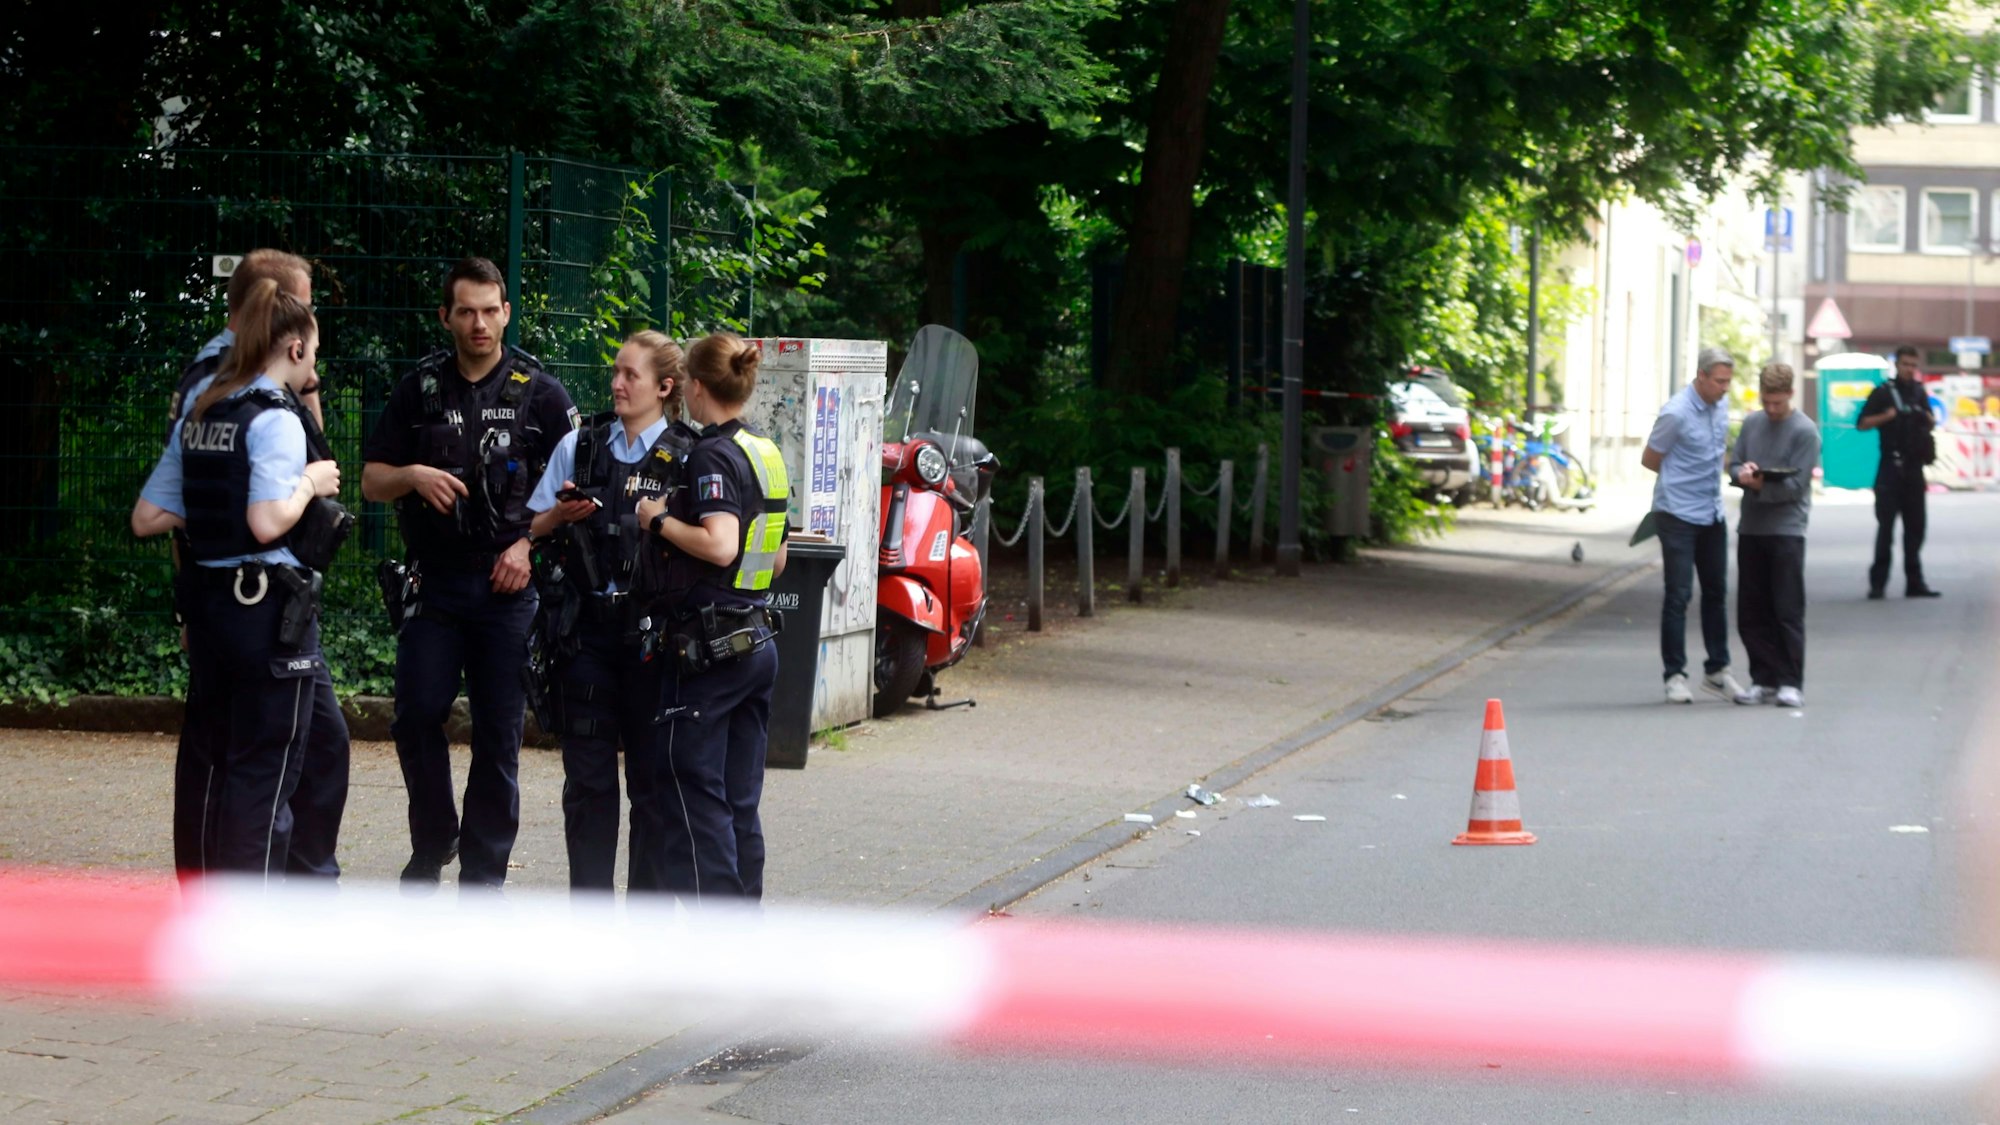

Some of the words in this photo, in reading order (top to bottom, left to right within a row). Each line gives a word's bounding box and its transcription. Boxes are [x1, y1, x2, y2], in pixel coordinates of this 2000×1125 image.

[481, 408, 515, 420] POLIZEI
[182, 421, 239, 452] POLIZEI
[633, 477, 662, 492] LIZEI
[775, 593, 799, 606] AWB
